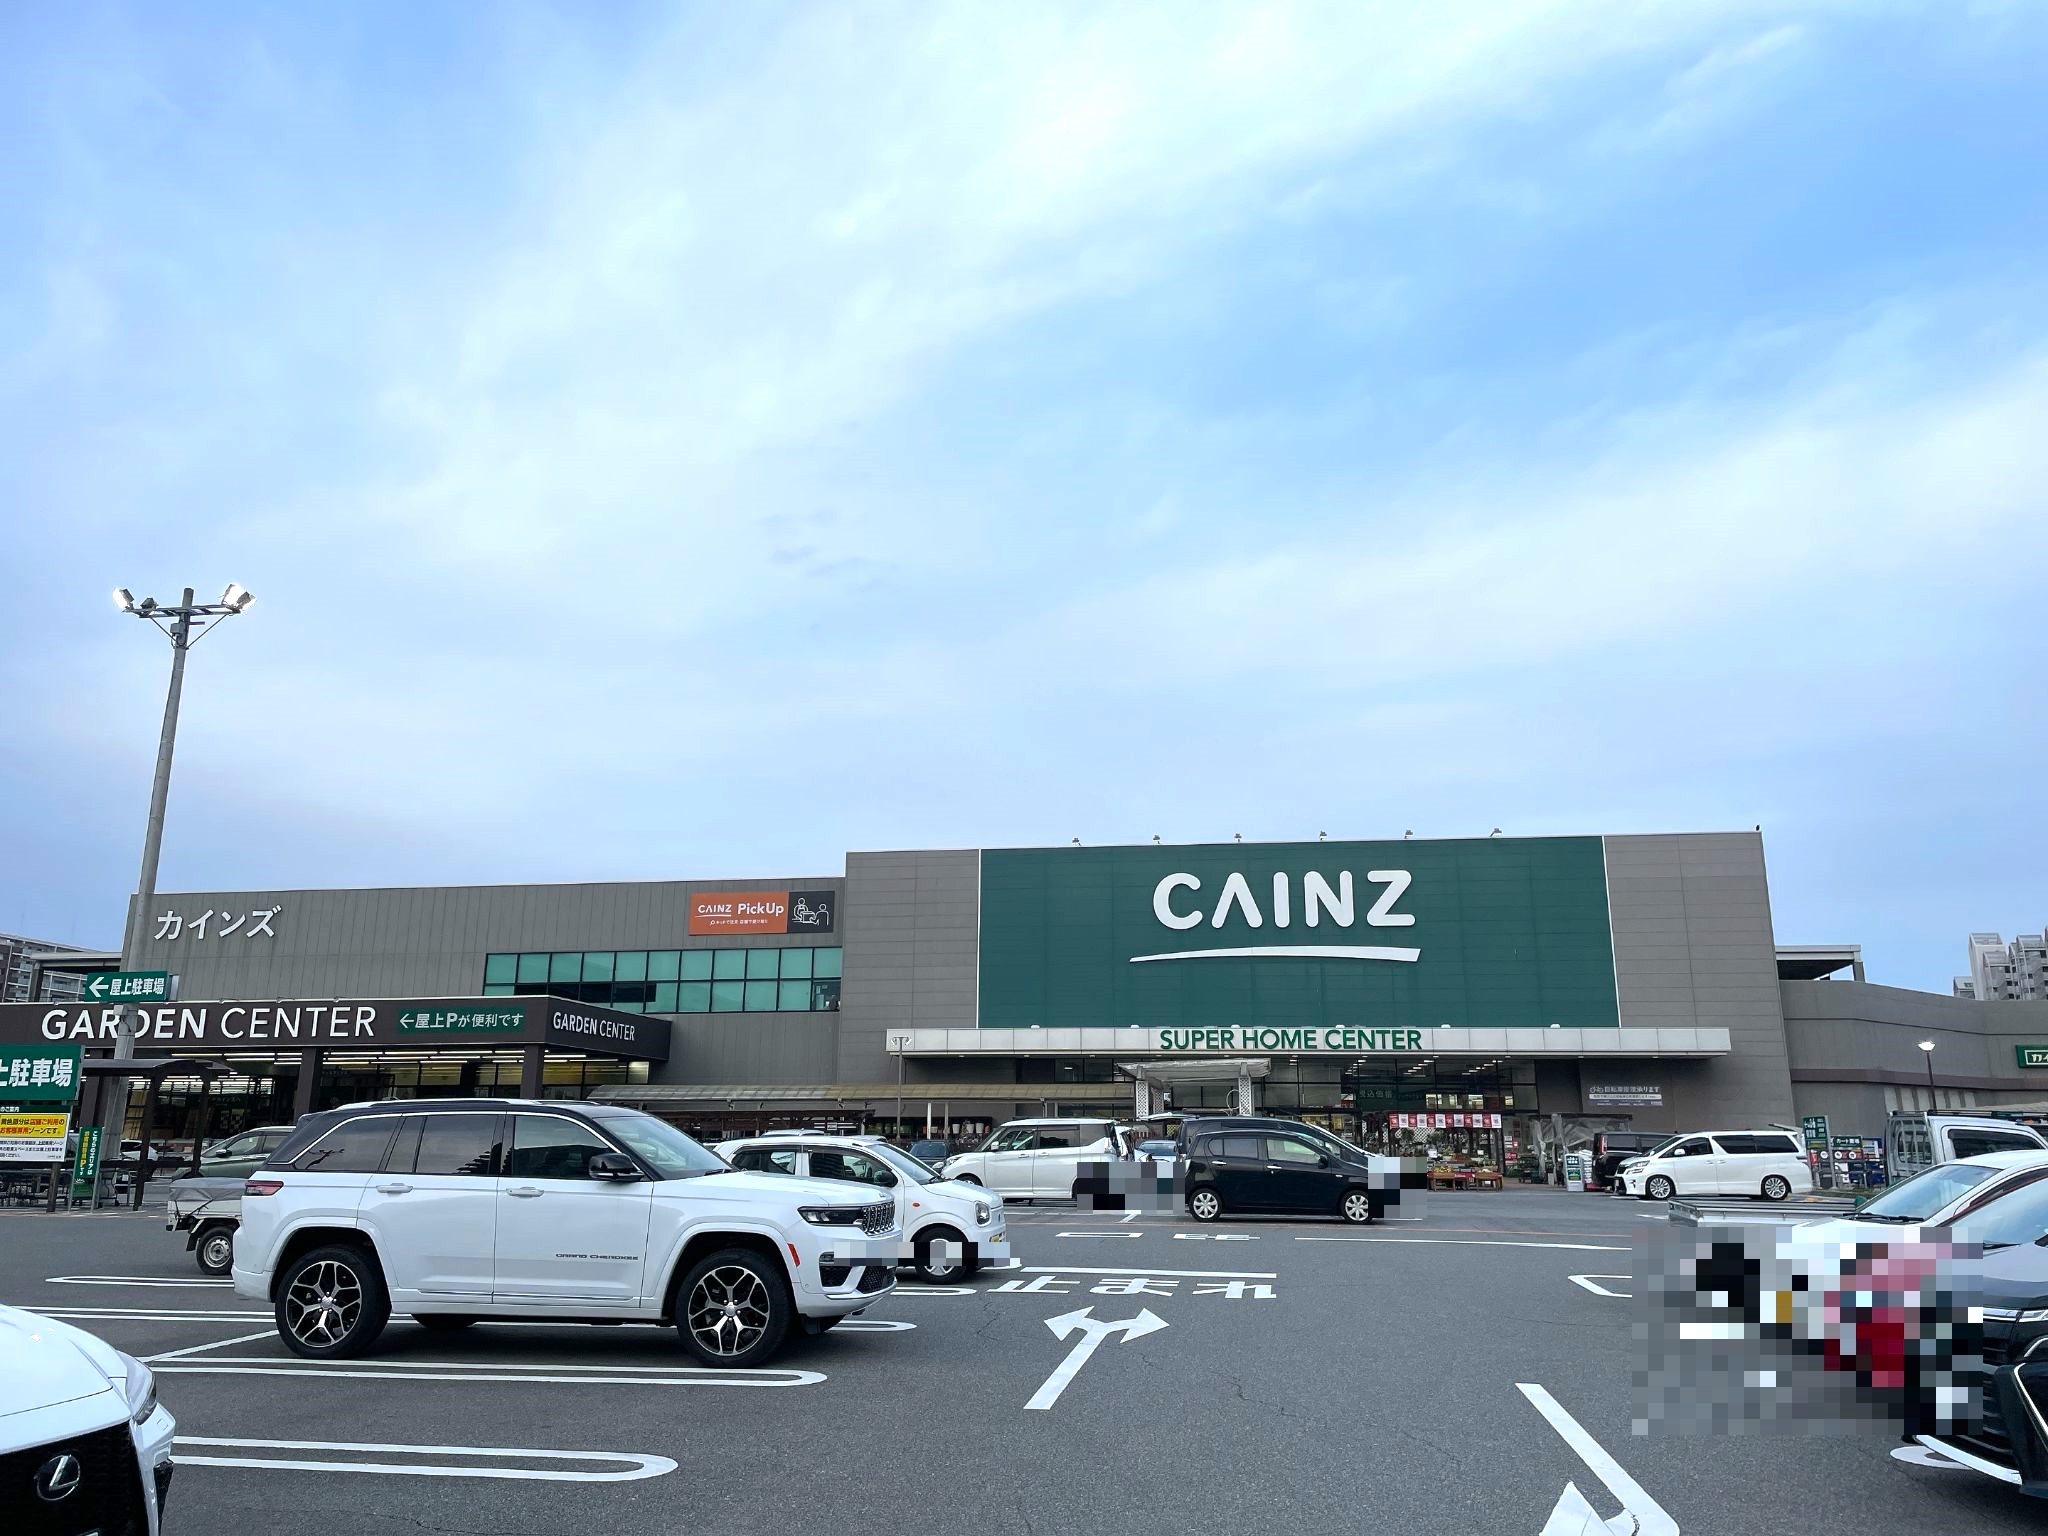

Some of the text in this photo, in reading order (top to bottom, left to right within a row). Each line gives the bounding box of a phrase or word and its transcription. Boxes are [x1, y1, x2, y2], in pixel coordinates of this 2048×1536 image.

[698, 904, 732, 914] CAINZ
[1153, 870, 1416, 930] CAINZ
[154, 905, 282, 940] カインズ
[109, 977, 164, 996] 屋上駐車場
[41, 1006, 376, 1040] GARDEN CENTER
[415, 1012, 524, 1029] 屋上Pが便利です
[553, 1011, 635, 1042] GARDEN CENTER
[1160, 1028, 1422, 1050] SUPER HOME CENTER
[986, 1275, 1277, 1299] 止まれ
